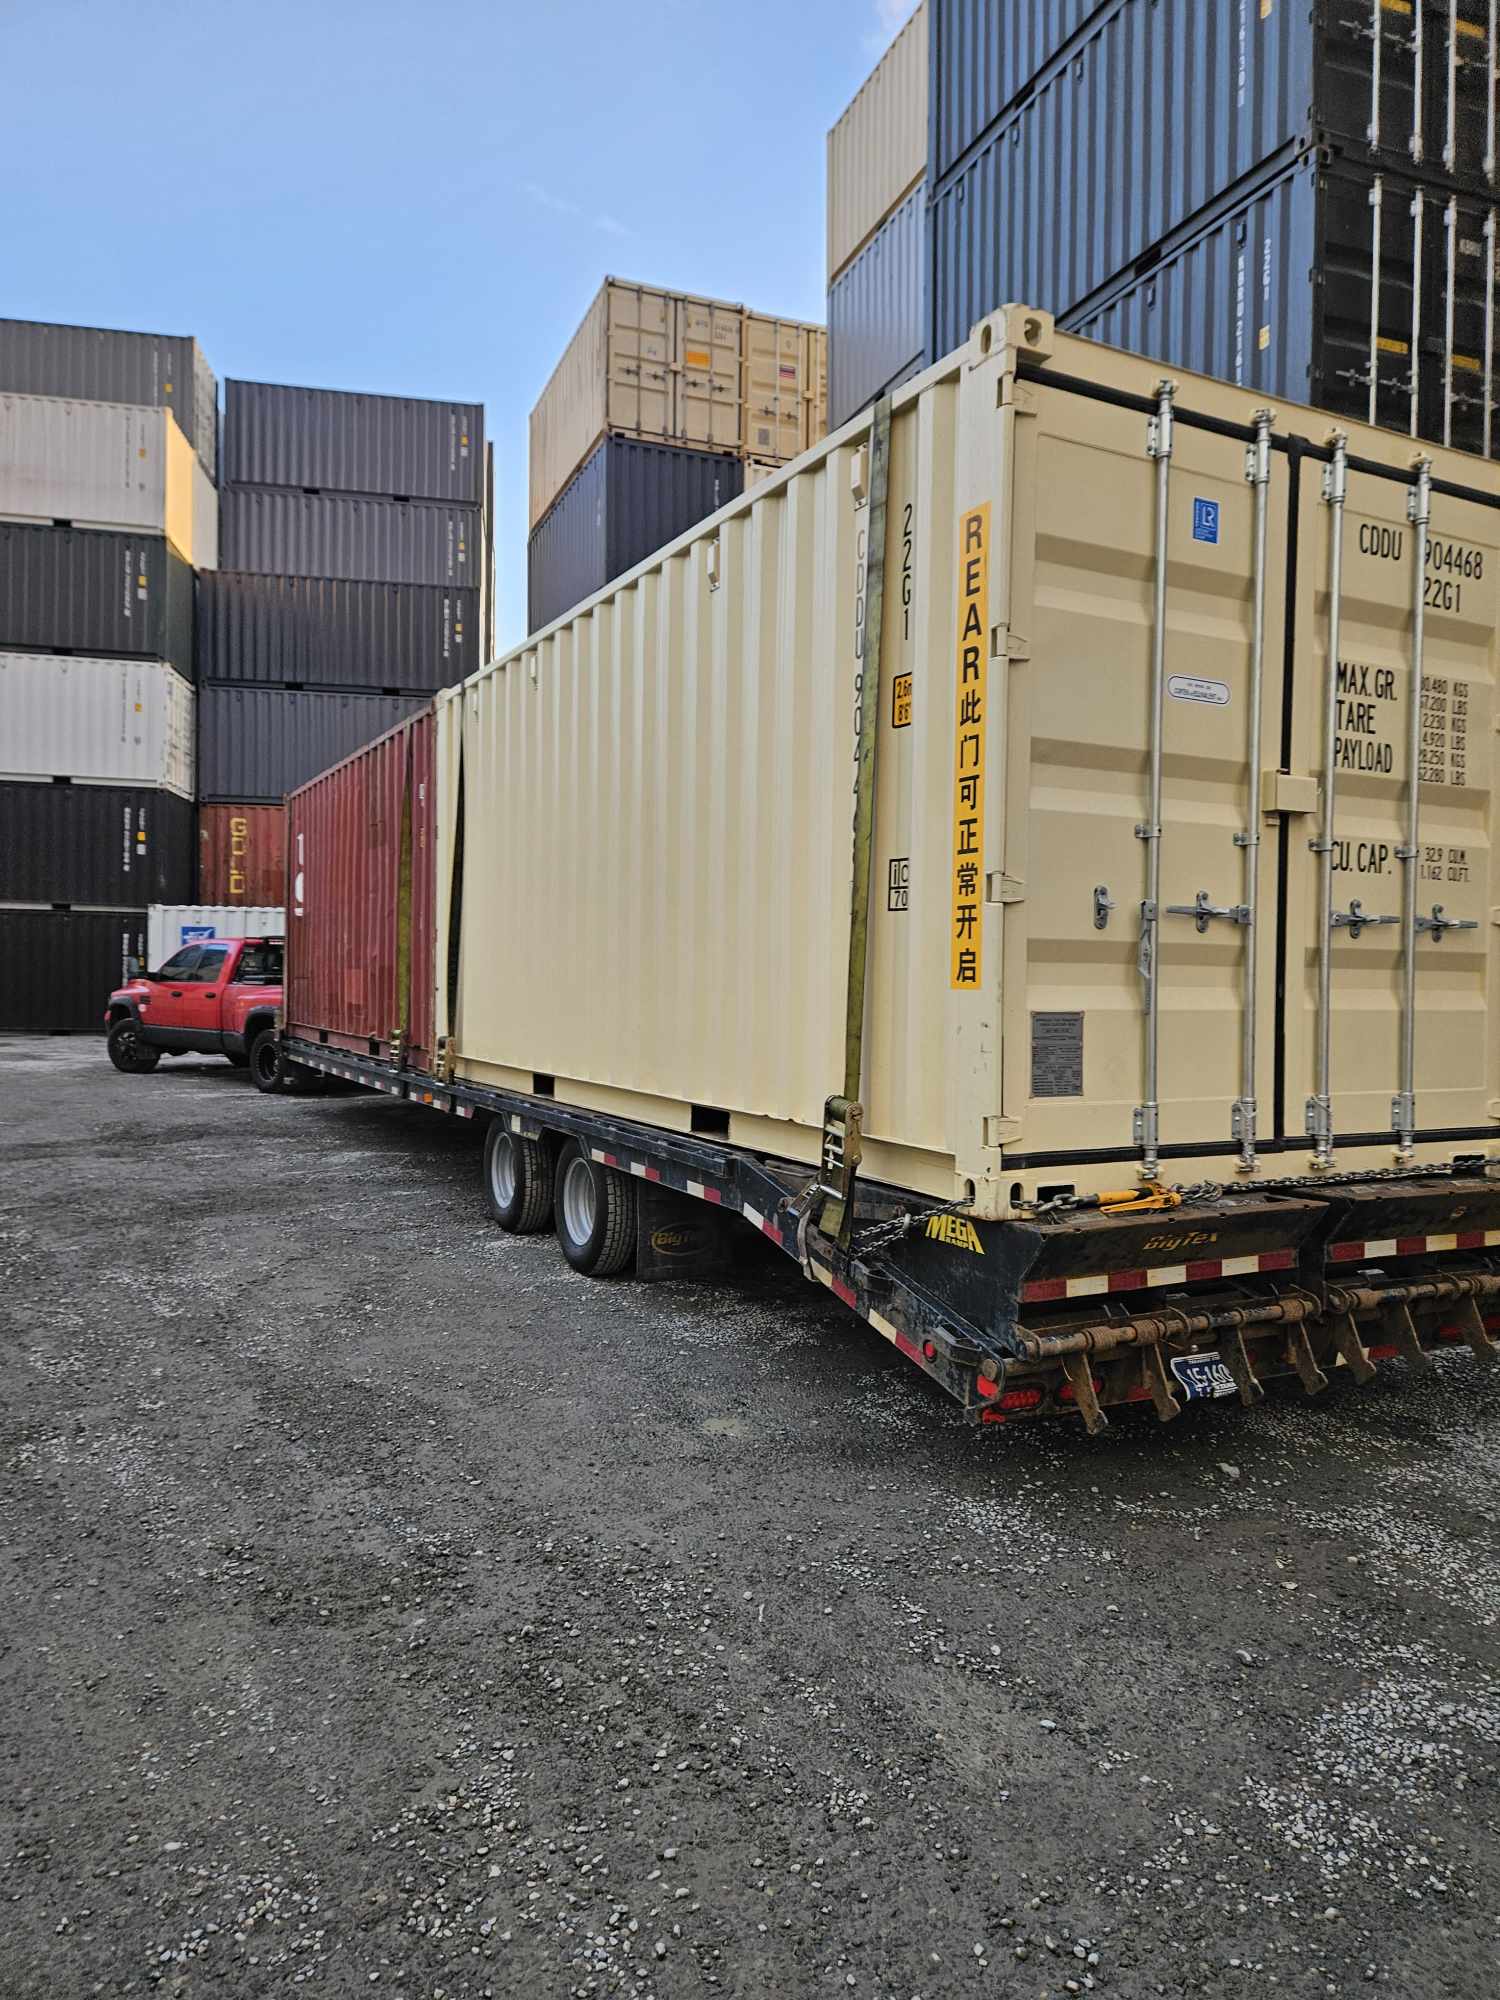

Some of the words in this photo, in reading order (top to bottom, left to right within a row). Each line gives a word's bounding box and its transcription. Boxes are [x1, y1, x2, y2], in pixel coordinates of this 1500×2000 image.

[1359, 523, 1403, 561] CDDU
[1424, 538, 1483, 580] 904468
[902, 503, 913, 641] 22G1
[962, 514, 983, 684] REAR
[1423, 576, 1462, 613] 22G1
[1336, 699, 1377, 735] TARE
[1334, 736, 1393, 774] PAYLOAD
[956, 689, 982, 983] 此门可正常开启
[1357, 843, 1392, 875] CAP.
[894, 891, 908, 907] 70
[925, 1214, 985, 1255] MEGA
